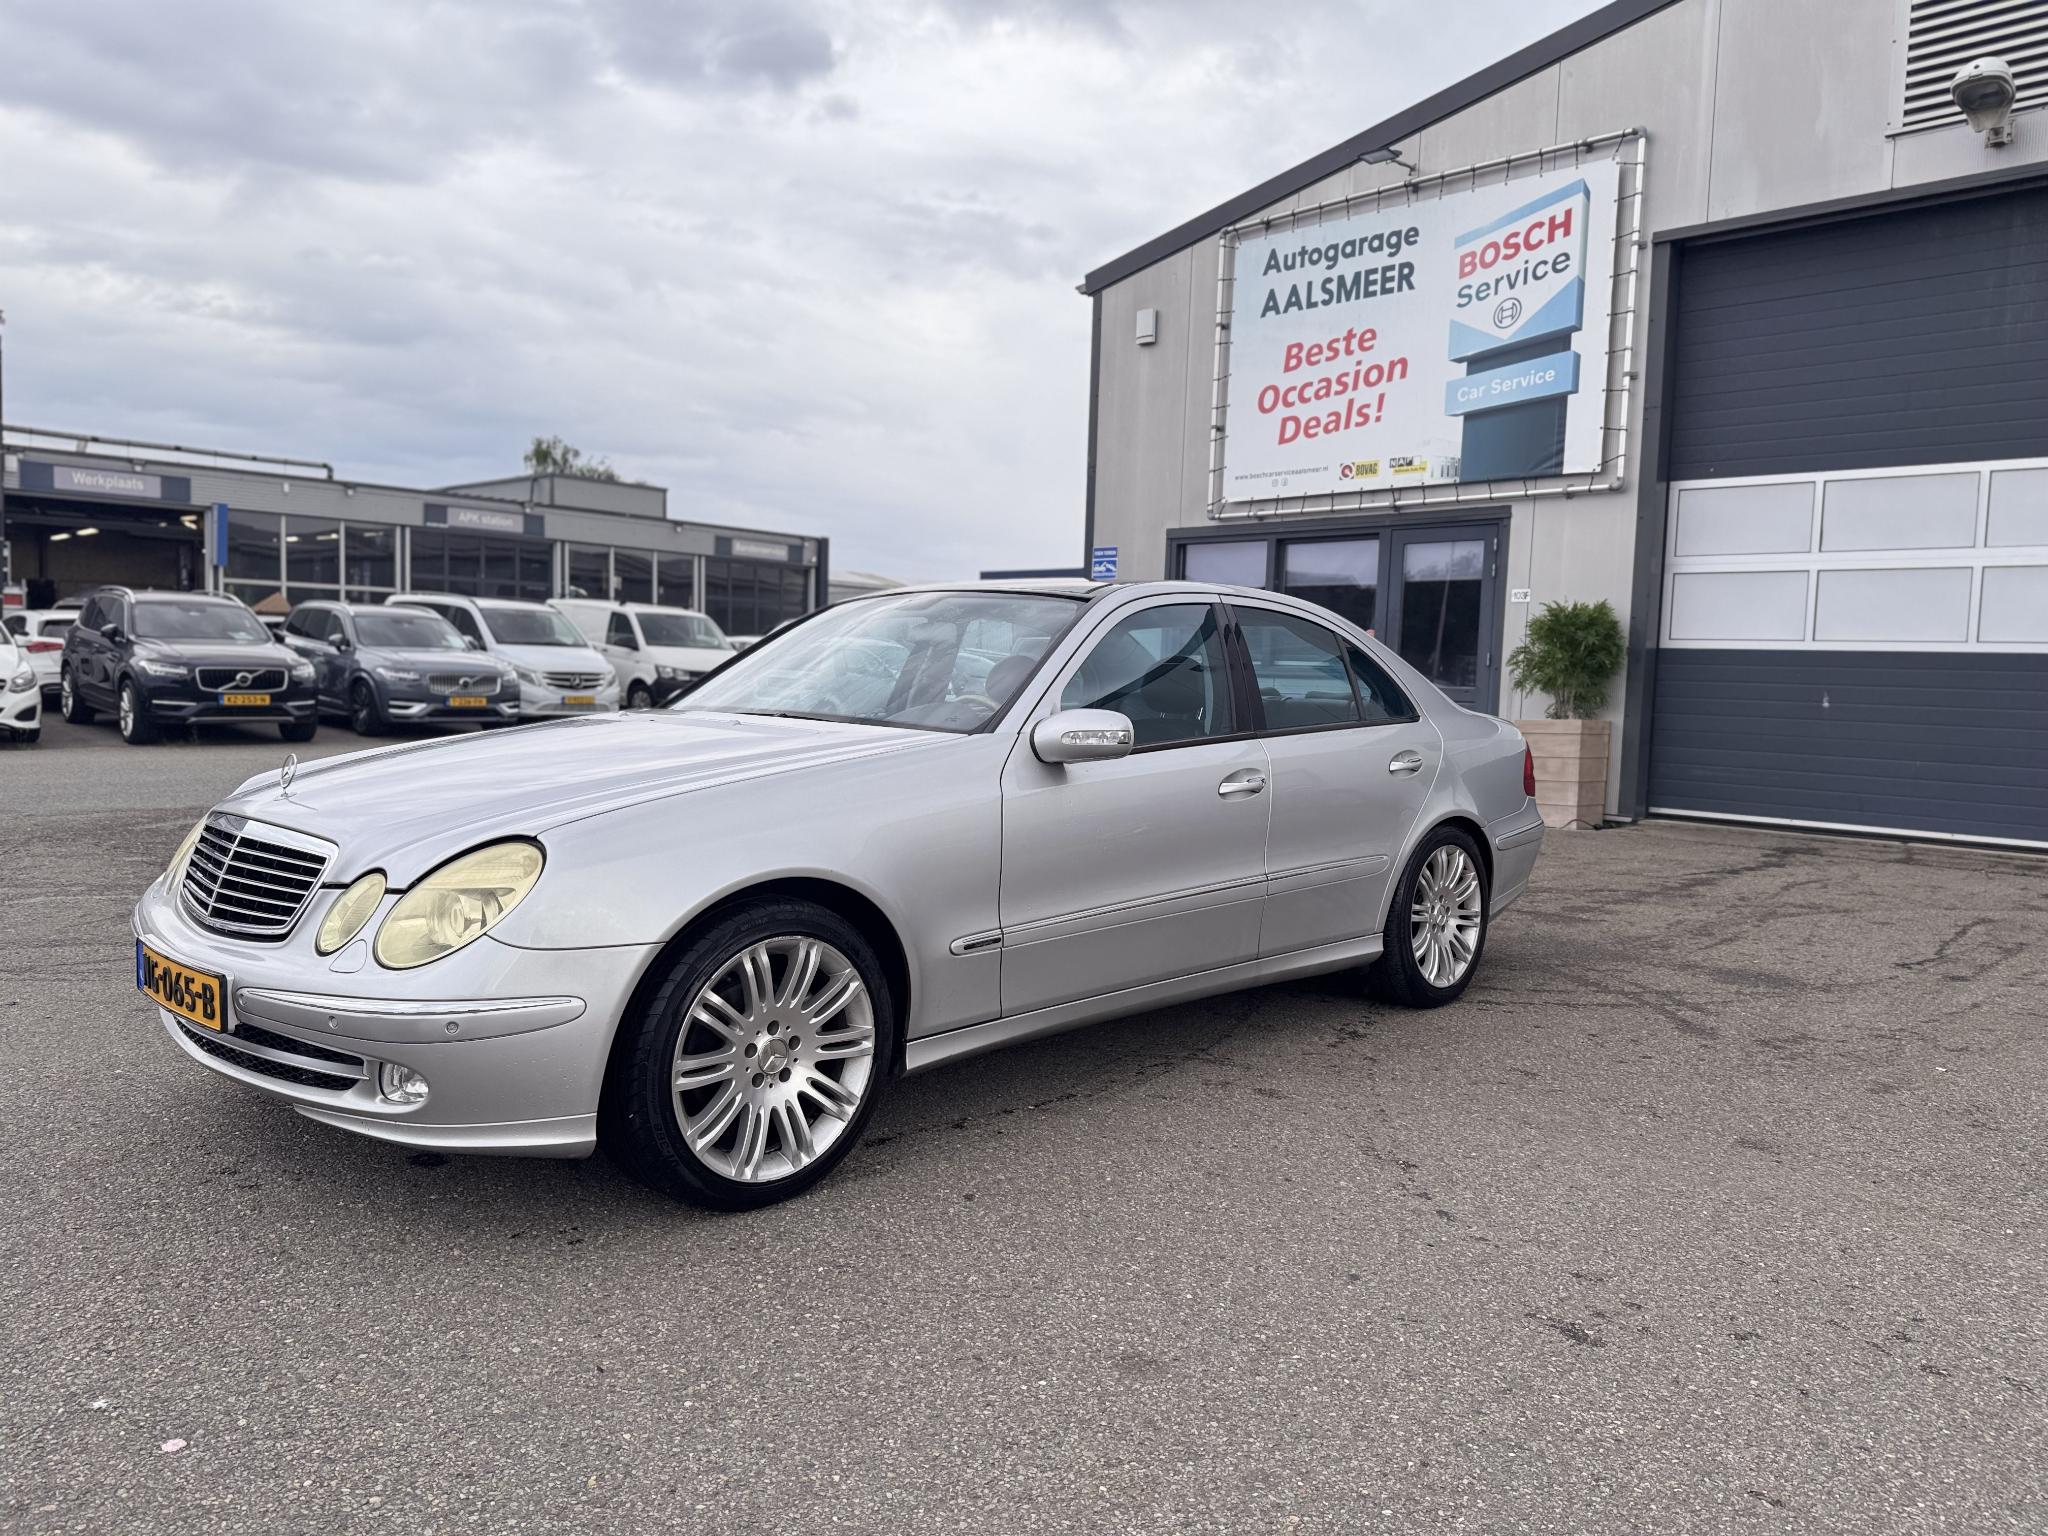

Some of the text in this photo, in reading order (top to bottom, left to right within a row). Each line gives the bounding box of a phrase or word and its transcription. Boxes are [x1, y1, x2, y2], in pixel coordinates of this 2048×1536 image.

[1262, 226, 1420, 277] Autogarage
[1458, 207, 1573, 280] BOSCH
[1260, 261, 1416, 319] AALSMEER
[1456, 251, 1572, 309] Service
[1283, 327, 1378, 374] Beste
[1257, 357, 1409, 414] Occasion
[1457, 368, 1556, 403] Car Service
[1278, 392, 1386, 446] Deals!
[72, 471, 144, 490] Werkplaats
[1355, 462, 1378, 476] BOVAG
